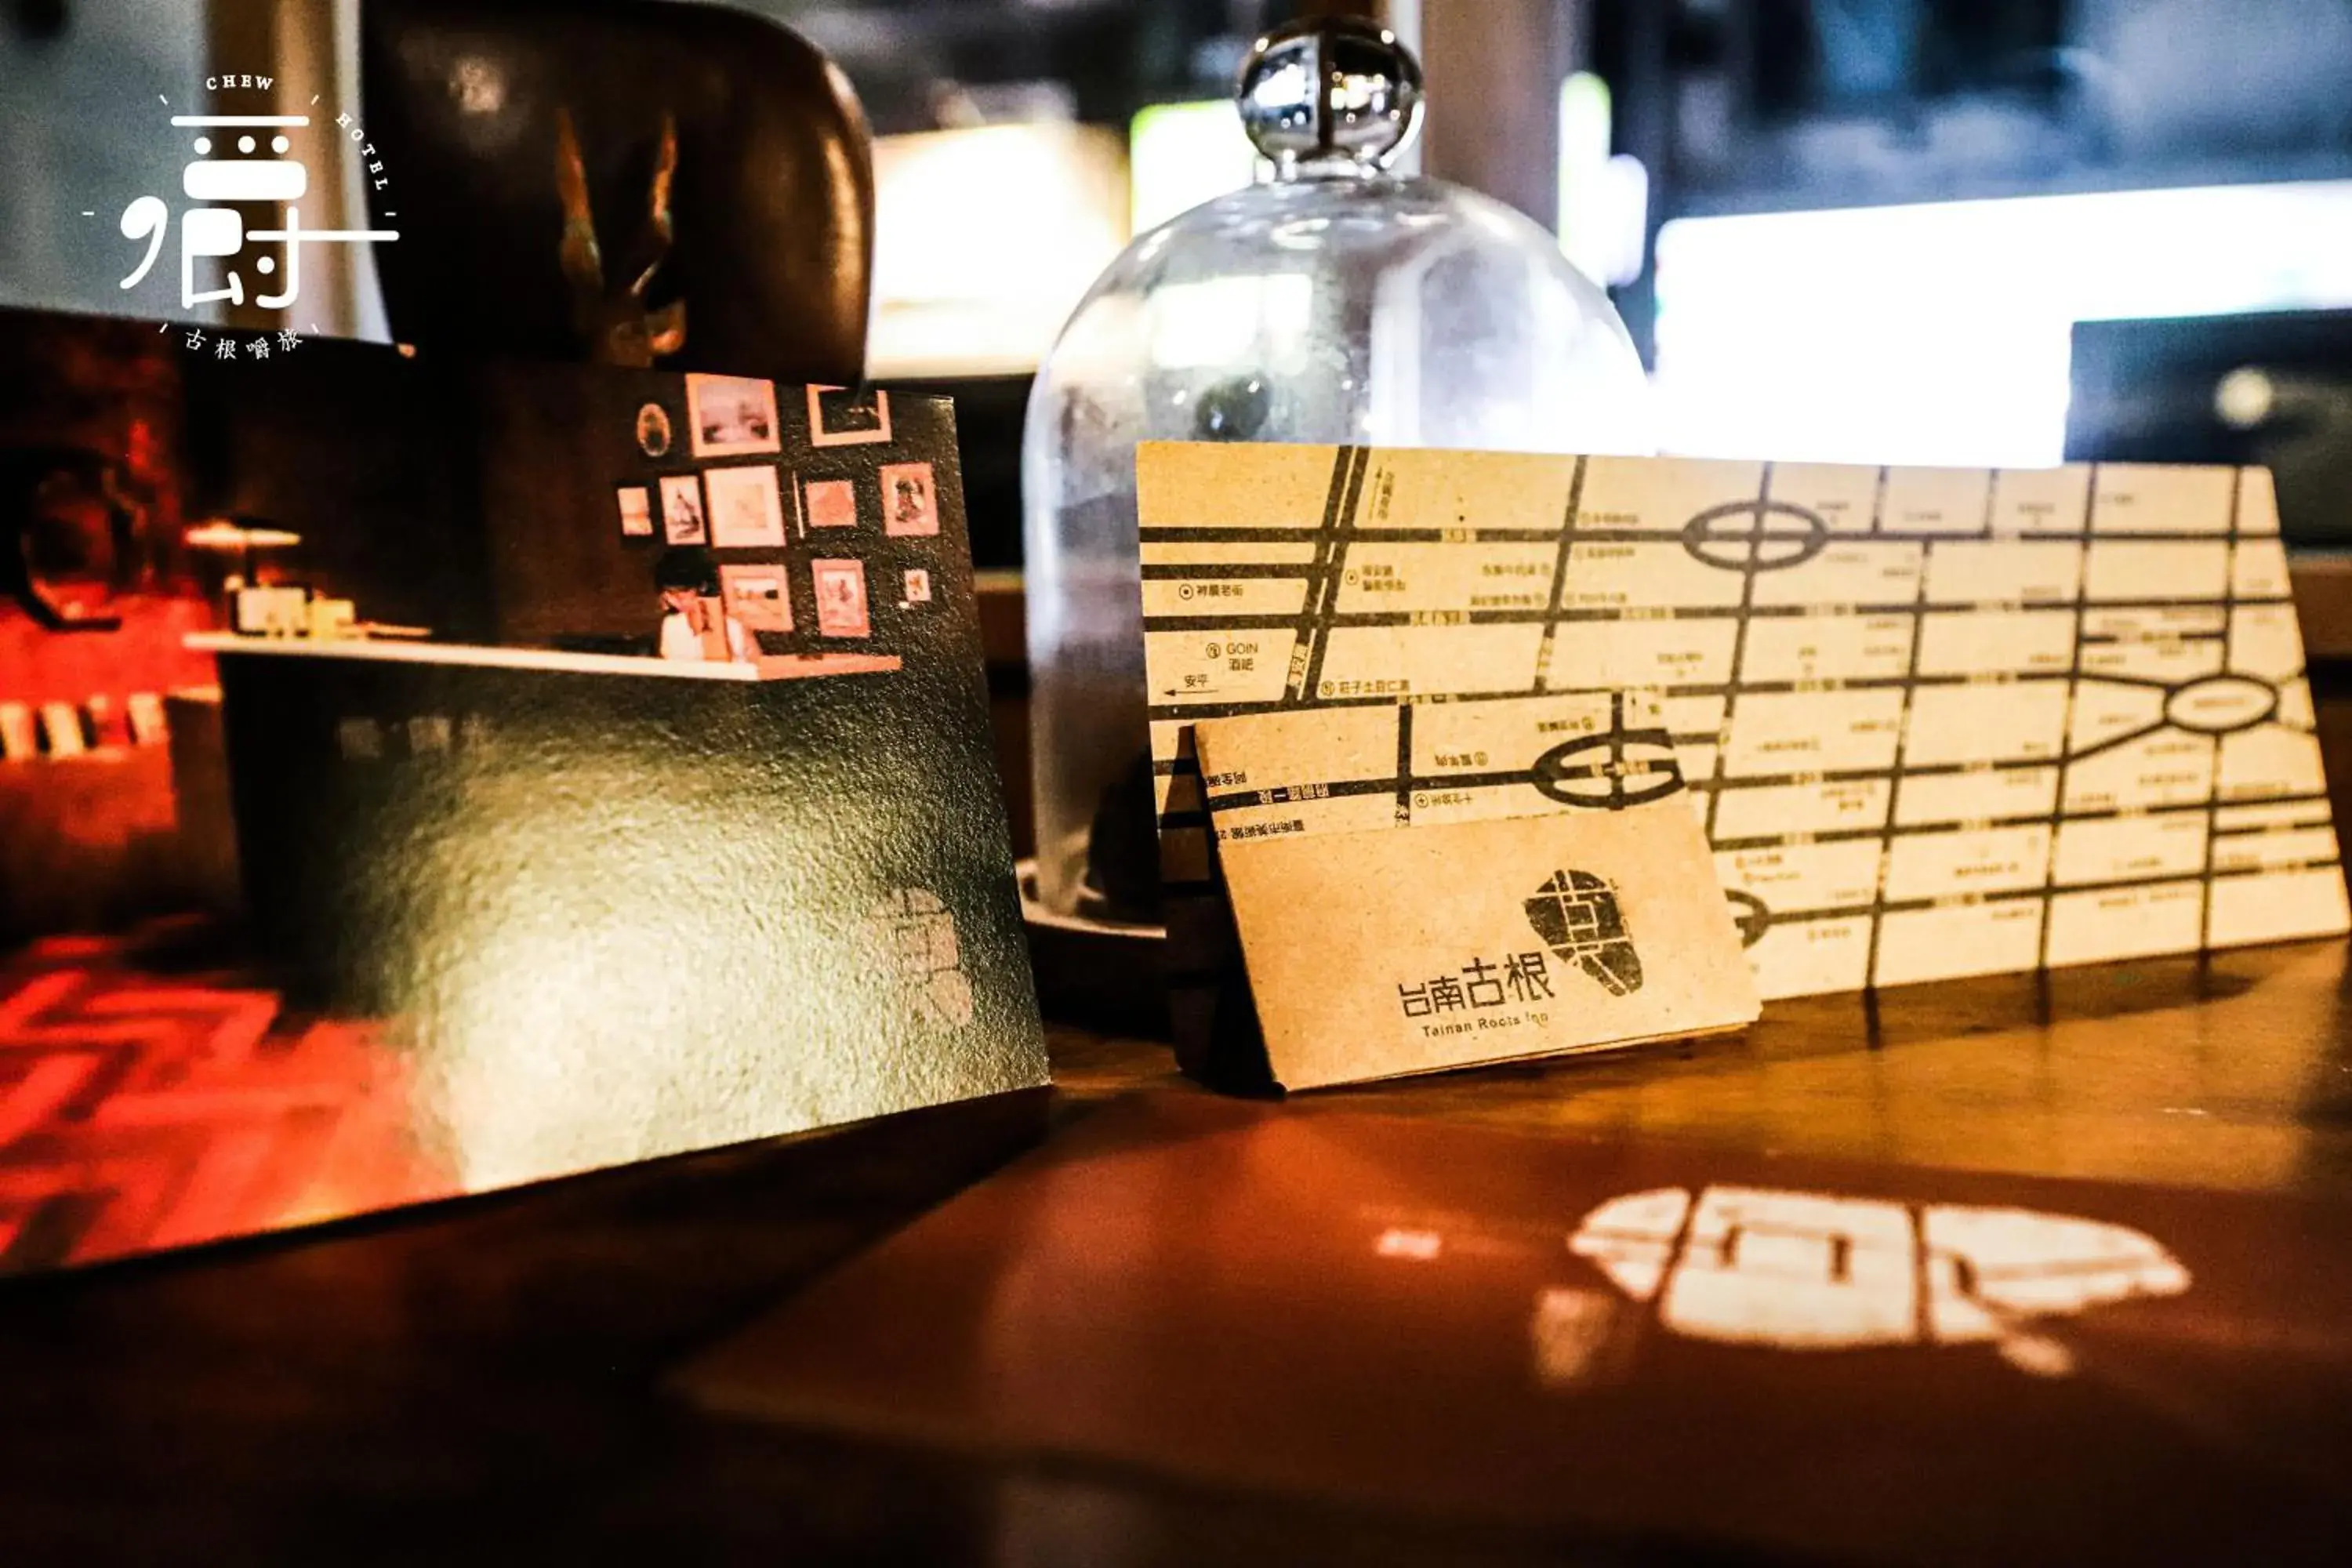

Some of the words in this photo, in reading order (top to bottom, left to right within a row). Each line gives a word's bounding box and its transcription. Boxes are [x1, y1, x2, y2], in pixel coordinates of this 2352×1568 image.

[1226, 642, 1259, 655] GOIN
[1229, 658, 1254, 672] 酒吧
[1184, 673, 1210, 688] 安平
[1421, 1021, 1473, 1039] Tainan
